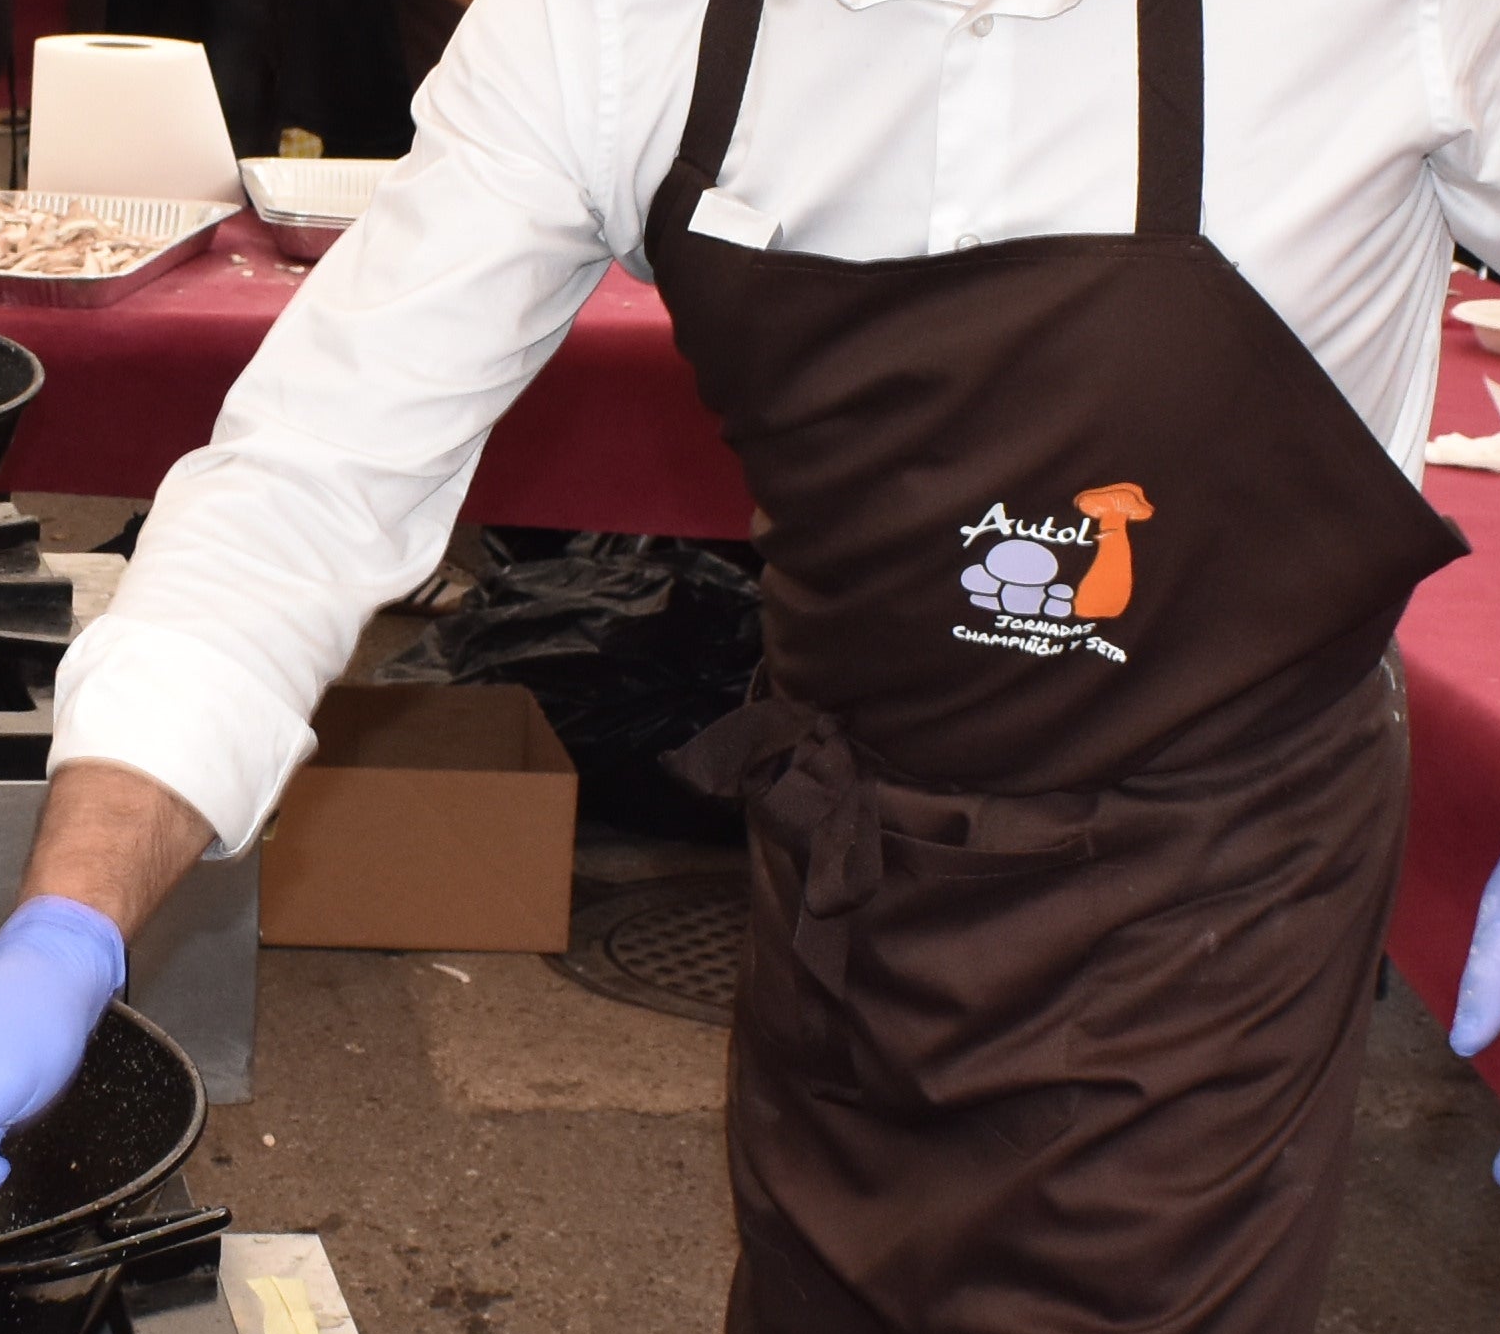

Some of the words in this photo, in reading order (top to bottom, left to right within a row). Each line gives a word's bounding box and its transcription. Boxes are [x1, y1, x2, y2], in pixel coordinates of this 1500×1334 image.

[959, 502, 1097, 549] Autol
[994, 614, 1097, 638] JORNADAS
[1085, 636, 1127, 663] SETA
